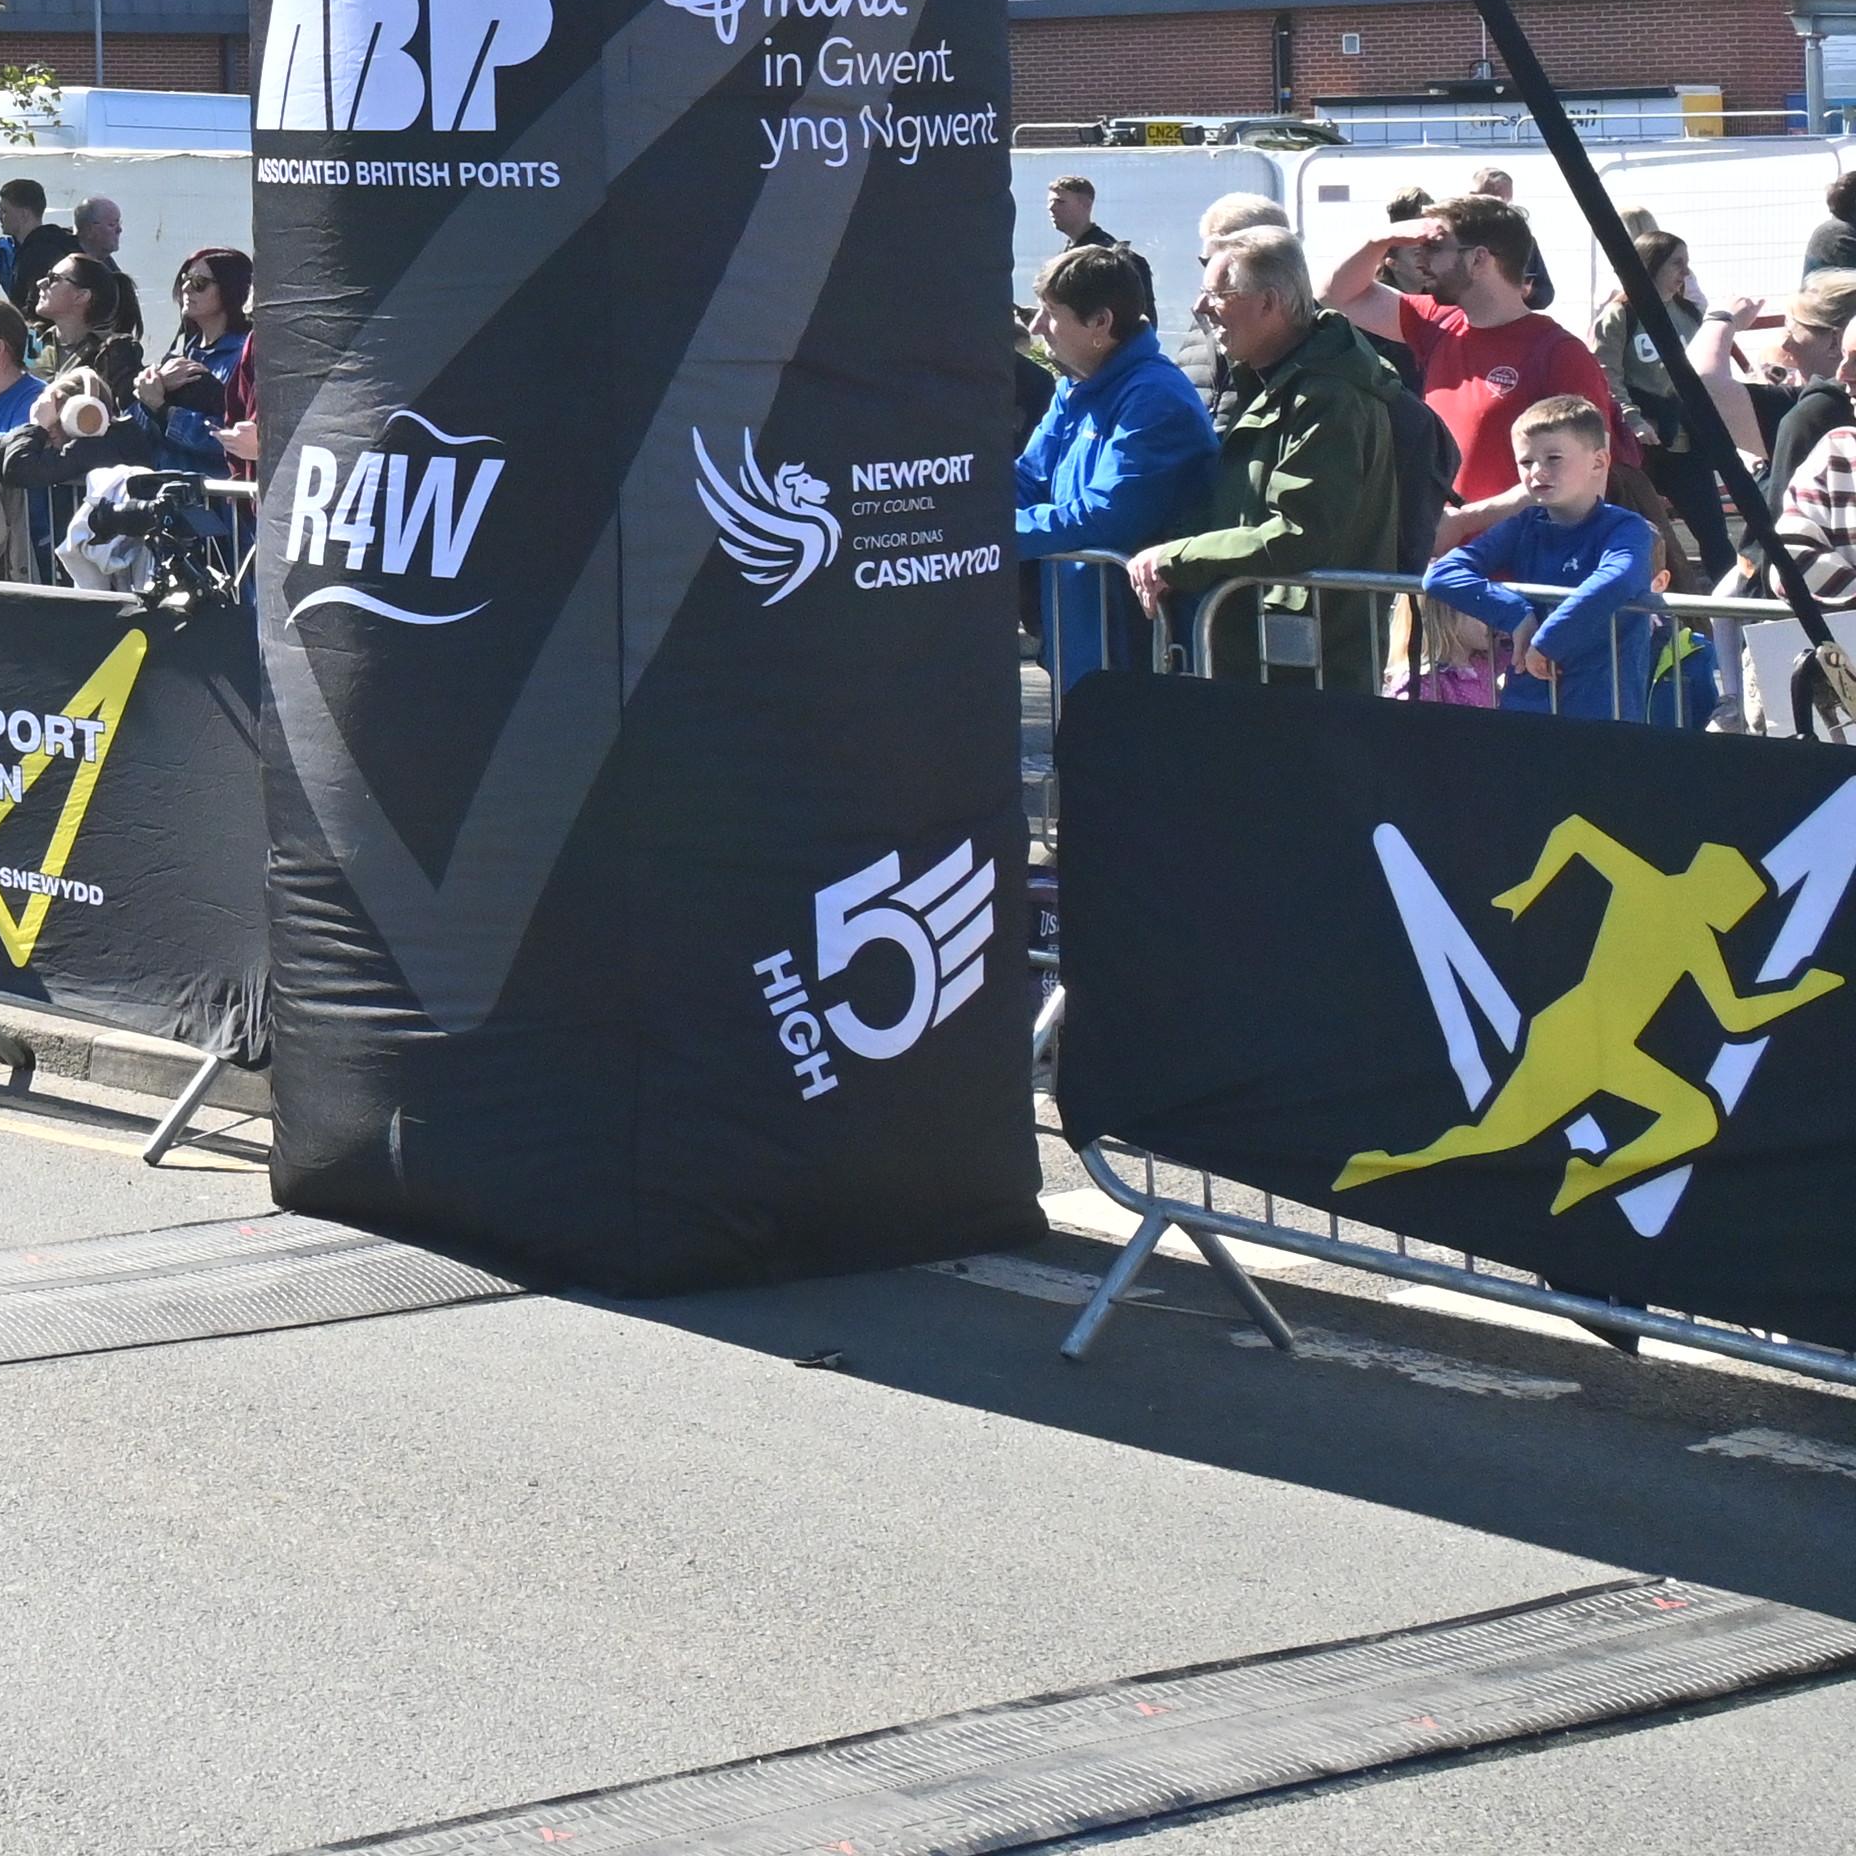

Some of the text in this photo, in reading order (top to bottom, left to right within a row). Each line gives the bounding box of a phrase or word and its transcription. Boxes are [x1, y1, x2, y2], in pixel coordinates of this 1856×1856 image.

[764, 37, 955, 87] in Gwent
[760, 103, 999, 169] yng Ngwent
[257, 158, 560, 188] ASSOCIATED BRITISH PORTS
[851, 453, 974, 493] NEWPORT
[283, 440, 505, 578] R4W
[852, 501, 880, 516] CITY
[853, 529, 944, 551] CYNGOR DINAS
[854, 544, 1001, 590] CASNEWYDD
[753, 950, 839, 1101] HIGH
